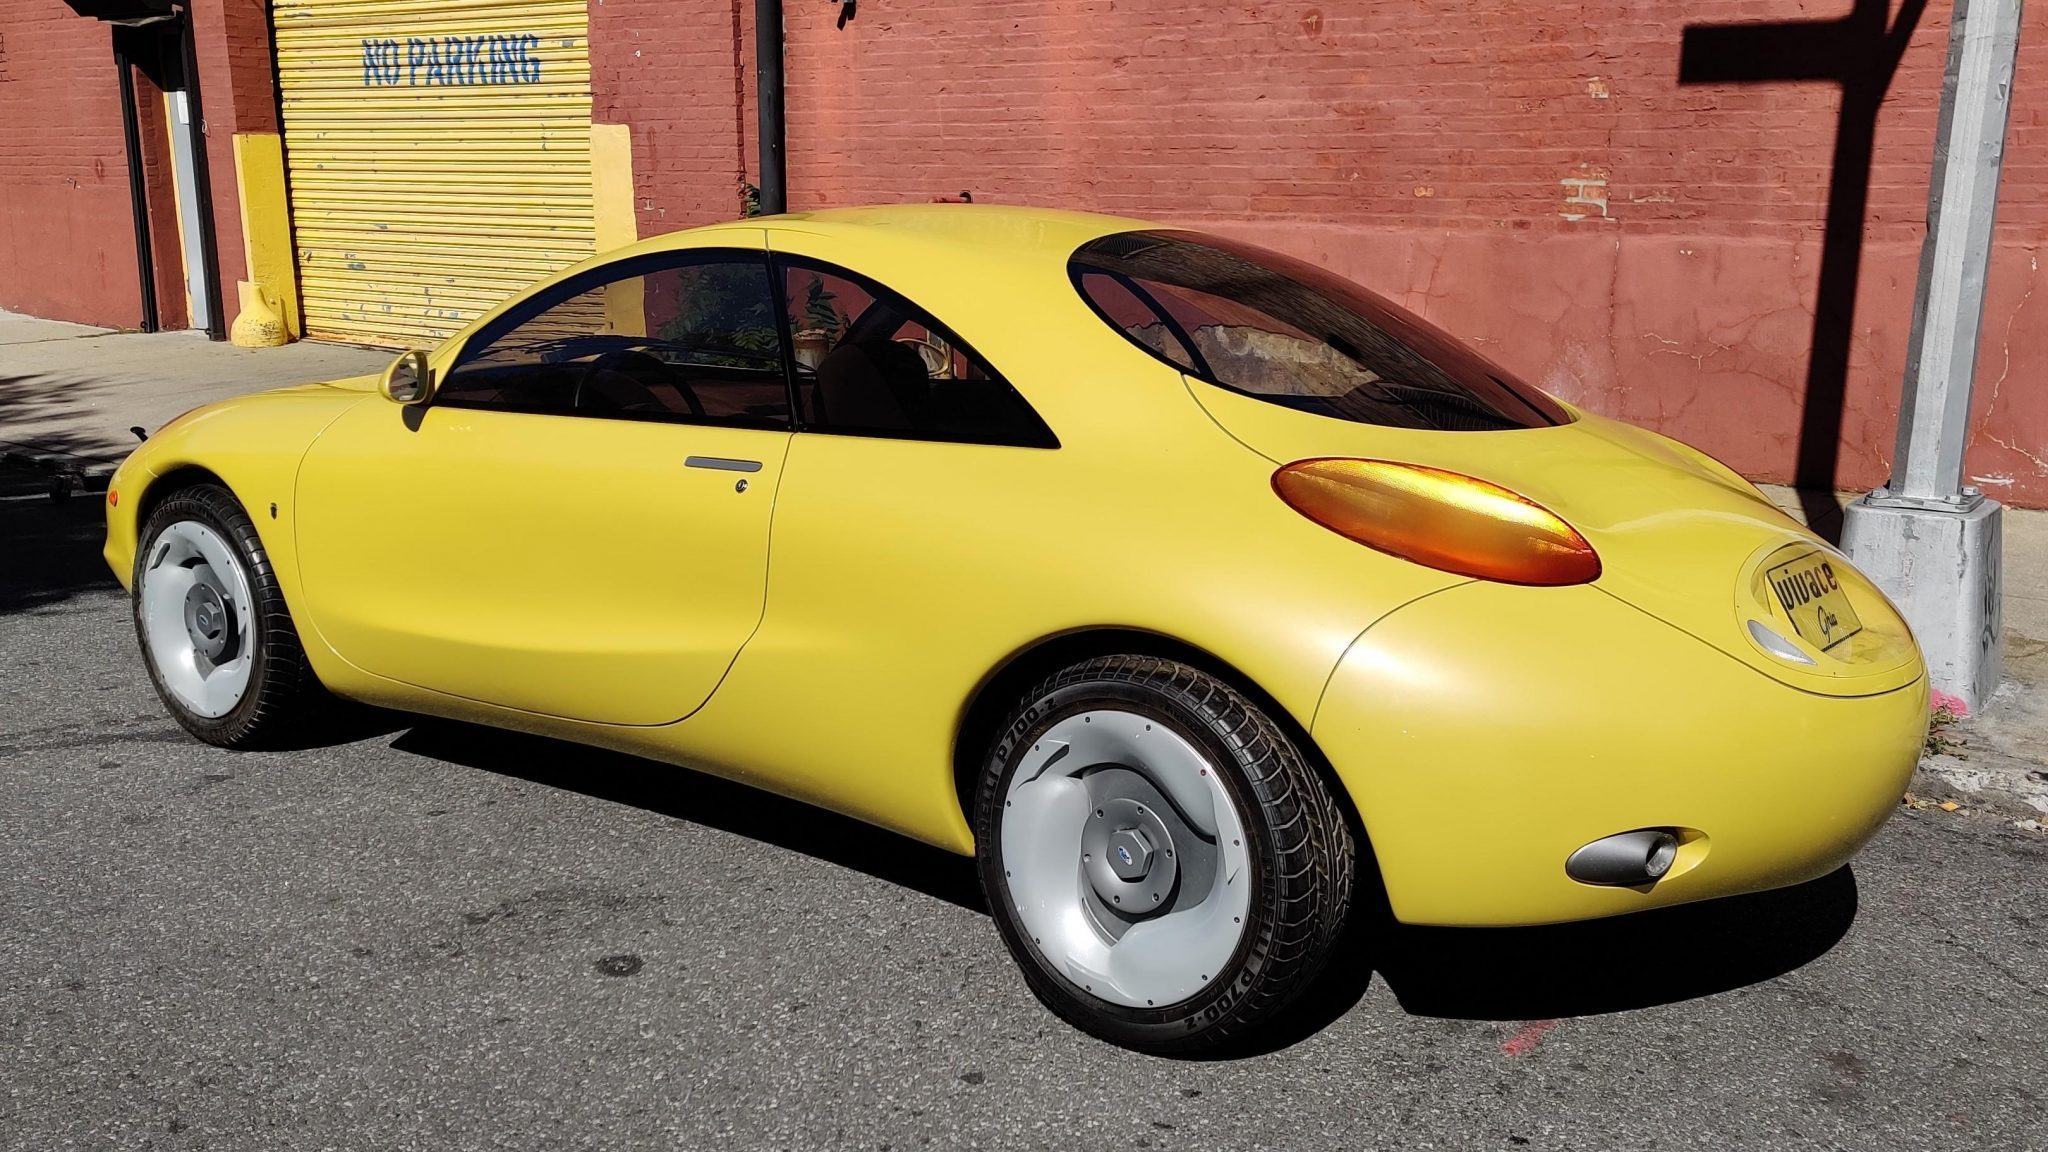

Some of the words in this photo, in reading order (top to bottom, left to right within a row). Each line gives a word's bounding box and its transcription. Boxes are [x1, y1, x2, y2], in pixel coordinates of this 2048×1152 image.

[362, 39, 399, 86] NO
[407, 33, 541, 86] PARKING
[1777, 563, 1837, 610] vivace
[1817, 605, 1838, 642] Ghia
[1253, 858, 1276, 960] PIRELLI
